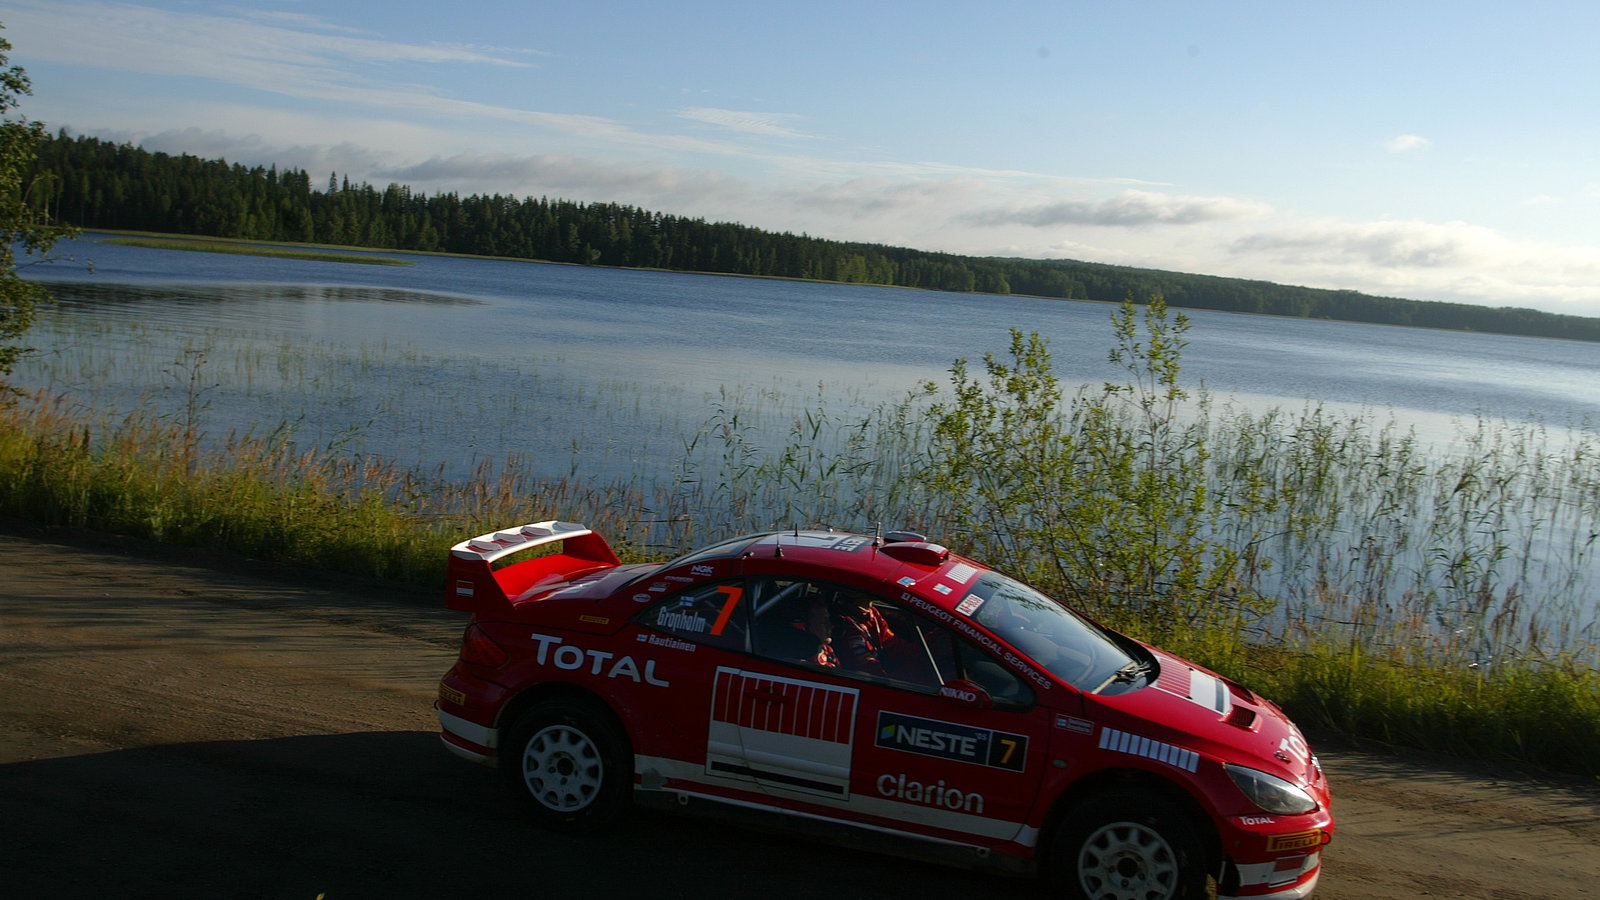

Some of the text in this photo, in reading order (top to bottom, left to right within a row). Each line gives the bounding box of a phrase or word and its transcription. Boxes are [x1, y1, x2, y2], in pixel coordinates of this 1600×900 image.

[691, 565, 715, 574] NGK
[709, 585, 744, 636] 7
[648, 634, 697, 653] Rautiainen
[909, 594, 955, 623] PEUGEOT
[952, 616, 1003, 656] FINANCIAL
[1004, 651, 1052, 690] SERVICES
[530, 633, 670, 688] TOTAL
[938, 687, 977, 702] NIKKO
[896, 725, 977, 757] NESTE
[1000, 739, 1017, 765] 7
[1239, 816, 1275, 826] TOTAL
